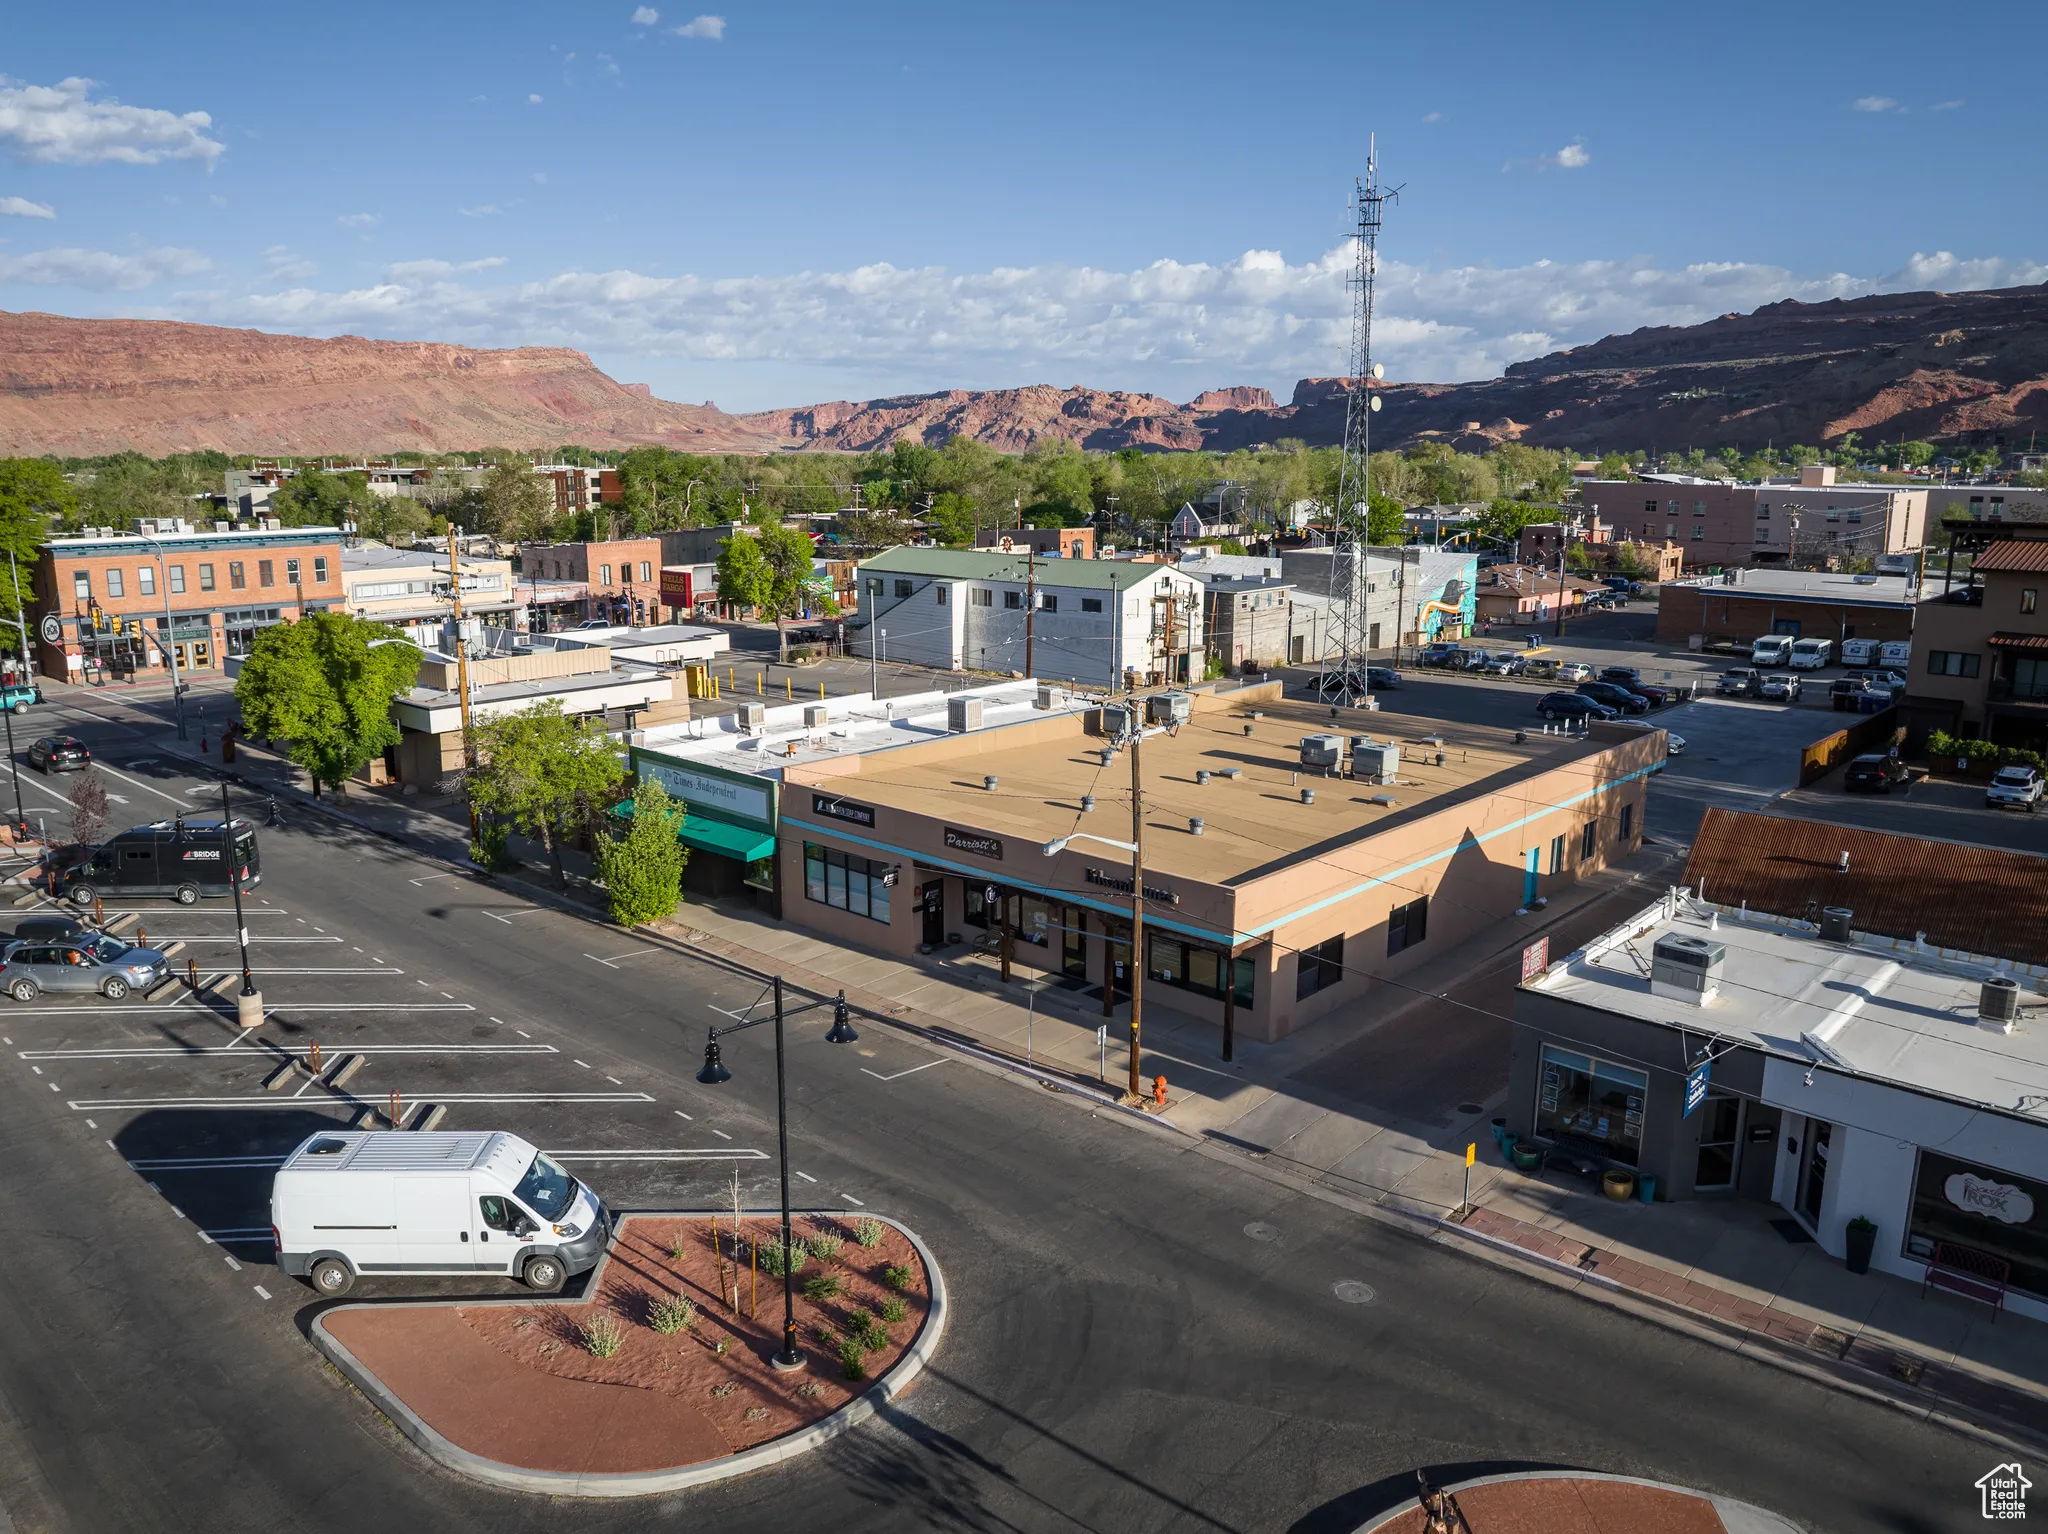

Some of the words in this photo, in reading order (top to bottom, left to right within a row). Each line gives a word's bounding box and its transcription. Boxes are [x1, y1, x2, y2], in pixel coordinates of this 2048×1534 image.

[662, 574, 684, 584] WELLS
[663, 583, 685, 592] FARGO
[946, 833, 998, 850] Parriott's
[1967, 1187, 2009, 1213] ROX
